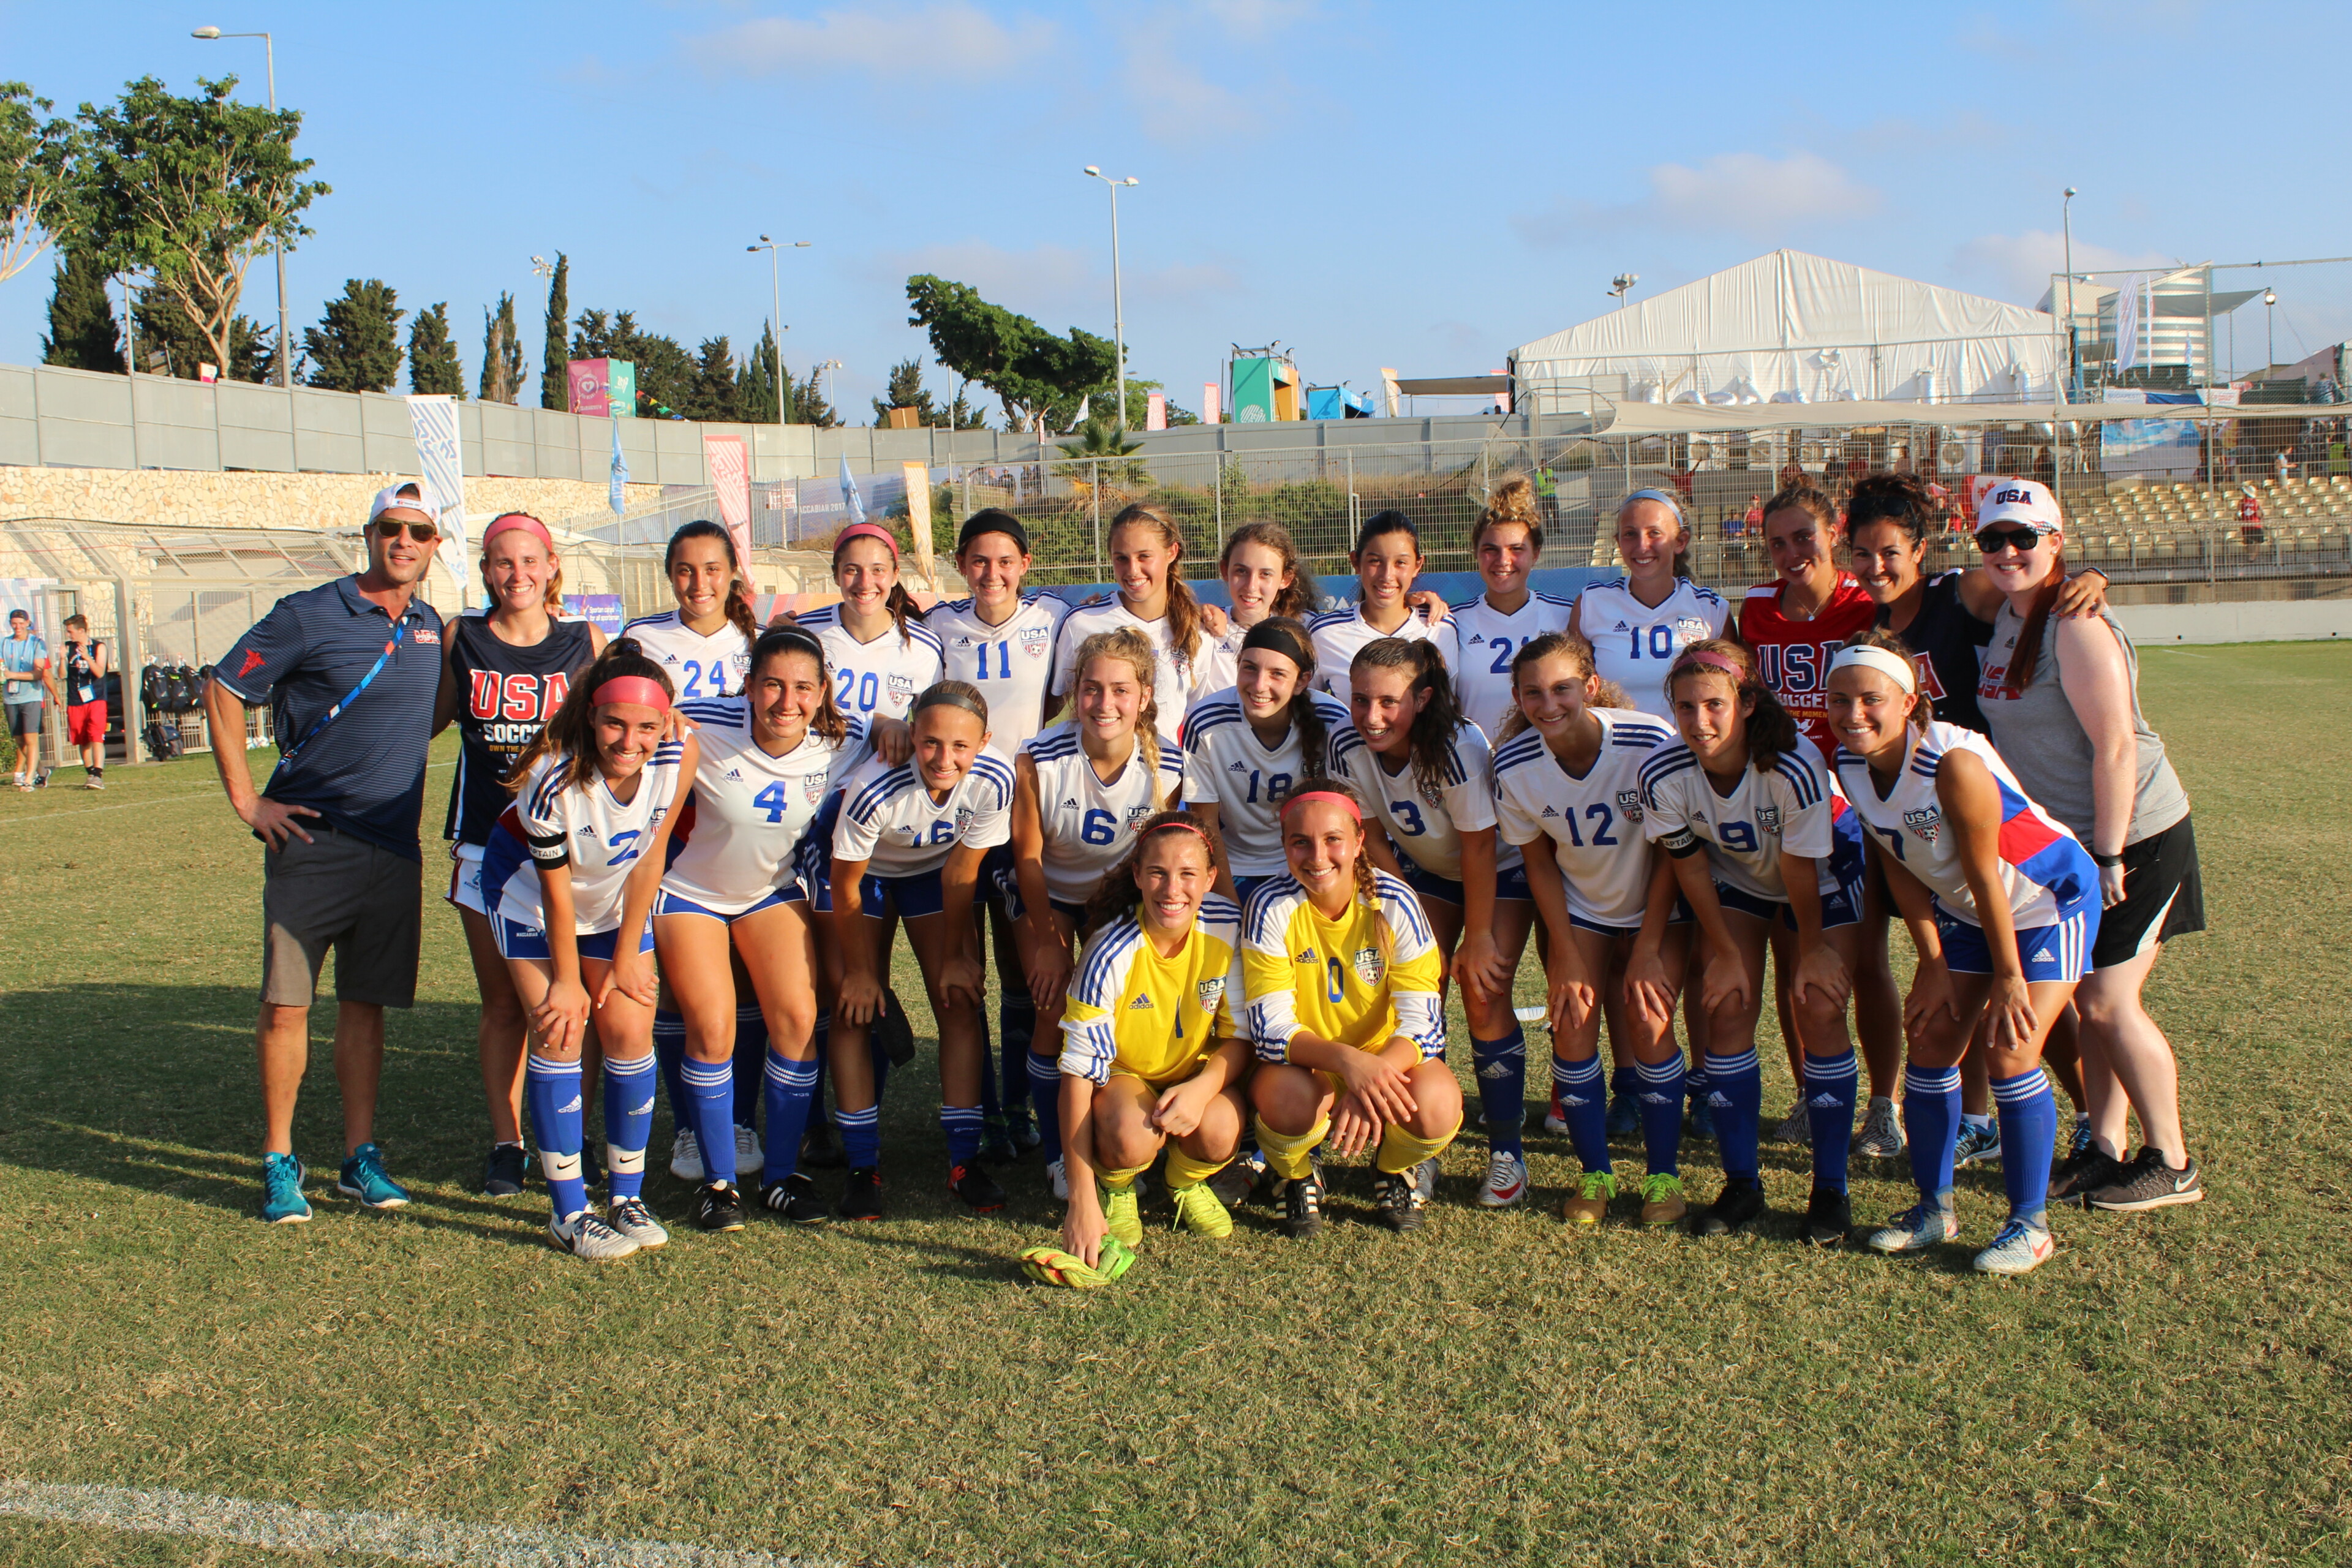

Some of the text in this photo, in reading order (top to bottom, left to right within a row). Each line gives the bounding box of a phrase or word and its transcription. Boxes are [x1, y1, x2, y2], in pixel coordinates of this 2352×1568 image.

[831, 502, 845, 511] 2017
[1996, 489, 2032, 505] USA
[1021, 628, 1047, 639] USA
[1678, 620, 1703, 630] USA
[413, 630, 440, 644] USA
[1630, 625, 1672, 659] 10
[977, 641, 1011, 679] 11
[1490, 636, 1529, 674] 2
[684, 660, 726, 697] 24
[835, 668, 878, 711] 20
[889, 676, 912, 689] USA
[805, 773, 827, 785] USA
[1246, 770, 1292, 804] 18
[753, 780, 788, 823] 4
[1060, 802, 1079, 810] adidas
[1619, 793, 1638, 804] US
[1128, 808, 1155, 817] USA
[1390, 800, 1427, 837] 3
[1691, 813, 1709, 823] adidas
[1904, 809, 1938, 824] USA
[910, 819, 954, 848] 16
[1081, 808, 1117, 845] 6
[1565, 802, 1618, 847] 12
[607, 829, 641, 866] 2
[1718, 820, 1758, 853] 9
[1871, 824, 1907, 862] 7
[1295, 954, 1319, 964] adidas
[1200, 979, 1225, 993] USA
[1327, 957, 1344, 1003] 0
[1128, 1001, 1155, 1009] adidas
[1174, 995, 1183, 1038] 1
[1479, 1069, 1514, 1079] adidas
